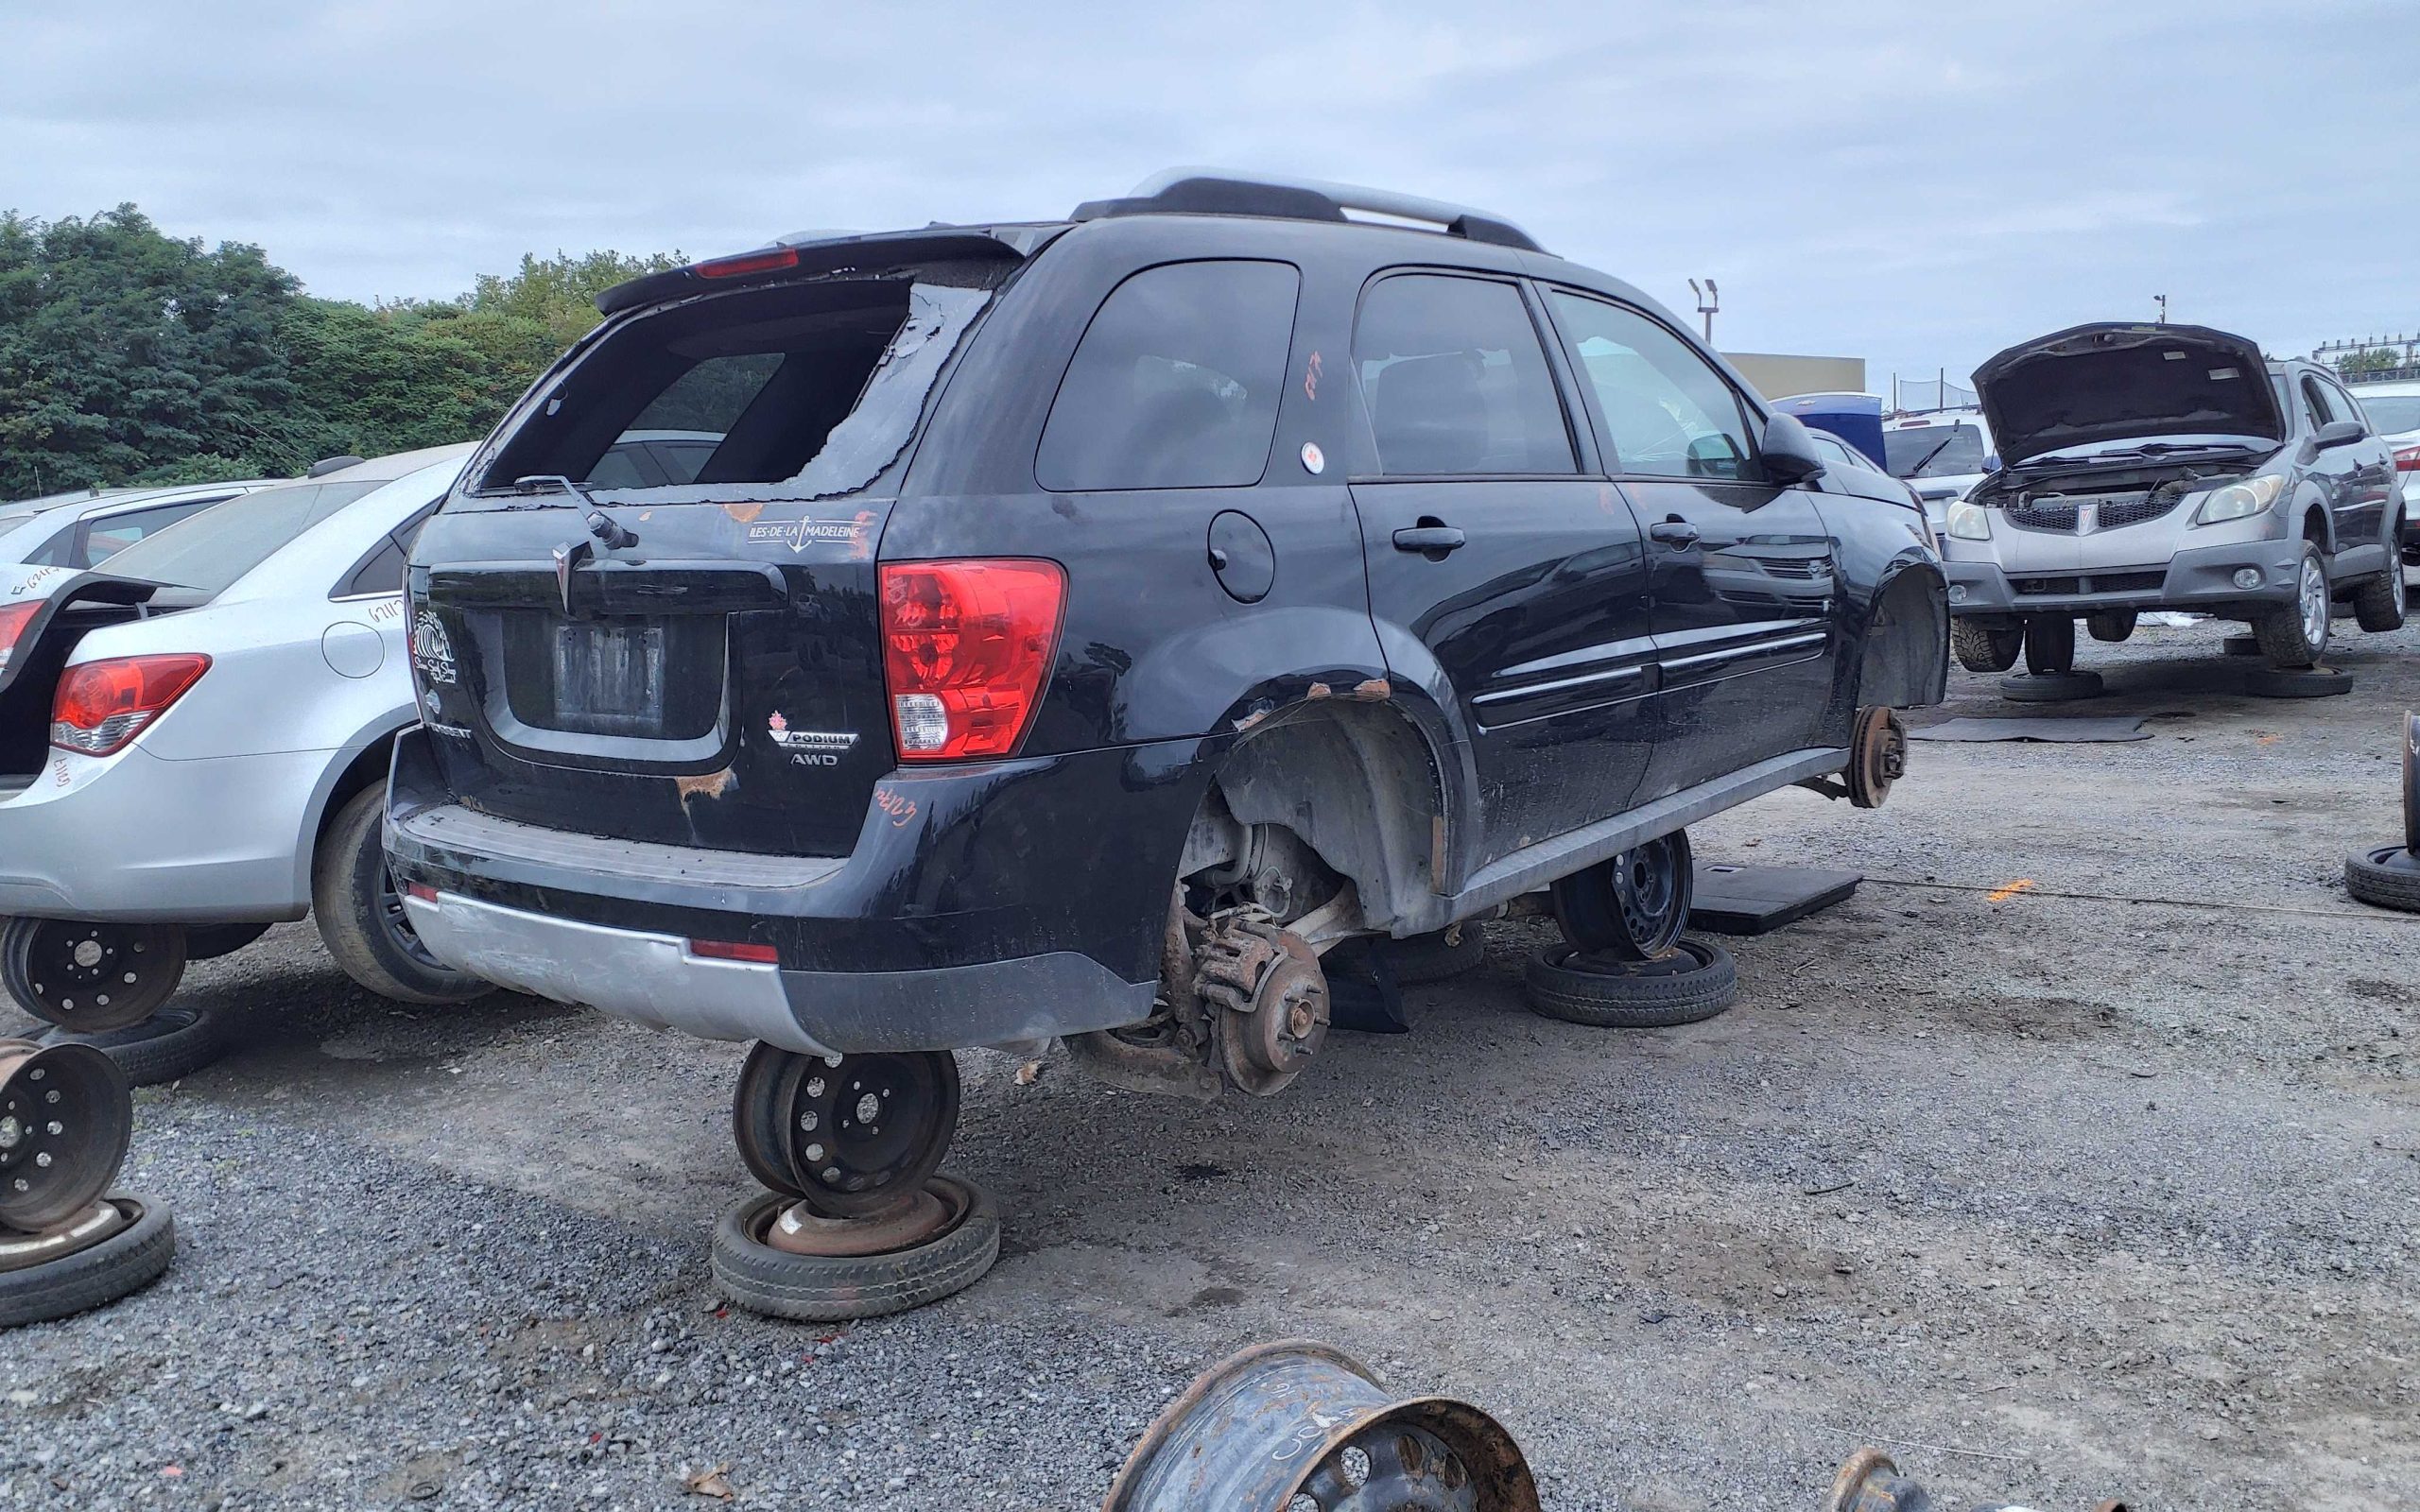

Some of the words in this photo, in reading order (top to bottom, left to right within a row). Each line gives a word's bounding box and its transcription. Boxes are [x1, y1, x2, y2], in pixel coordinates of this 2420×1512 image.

[804, 526, 860, 538] MADELEINE
[792, 733, 852, 745] PODIUM
[789, 753, 838, 766] AWD
